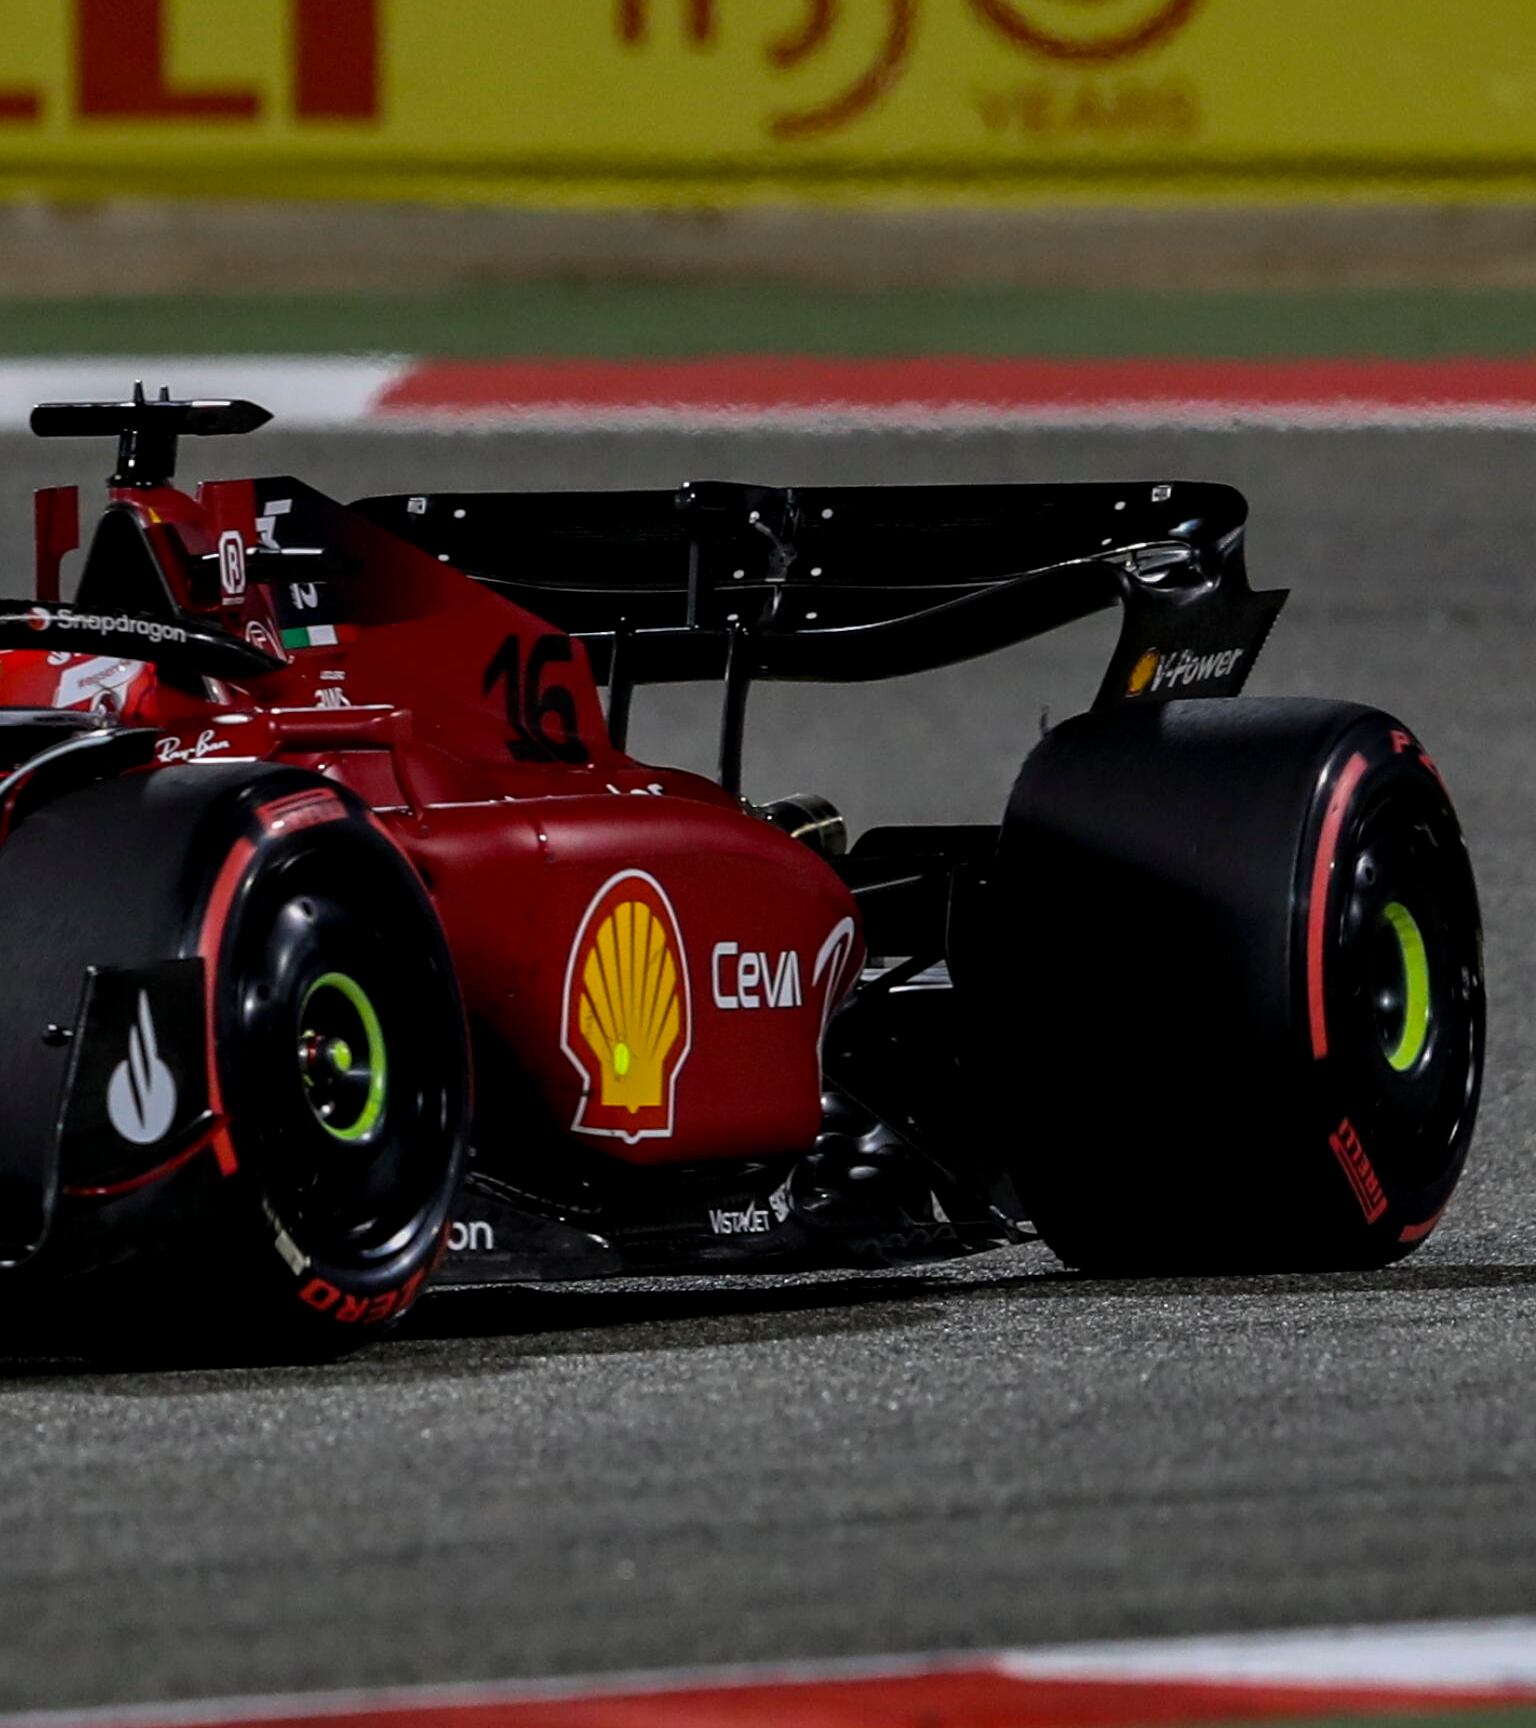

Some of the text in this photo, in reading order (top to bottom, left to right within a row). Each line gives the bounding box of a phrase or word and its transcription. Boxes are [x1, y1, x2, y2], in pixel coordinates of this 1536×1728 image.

[56, 609, 187, 643] Snapdragon
[1150, 648, 1244, 691] V-Power
[484, 634, 588, 763] 16
[155, 729, 230, 763] Ray-Ban
